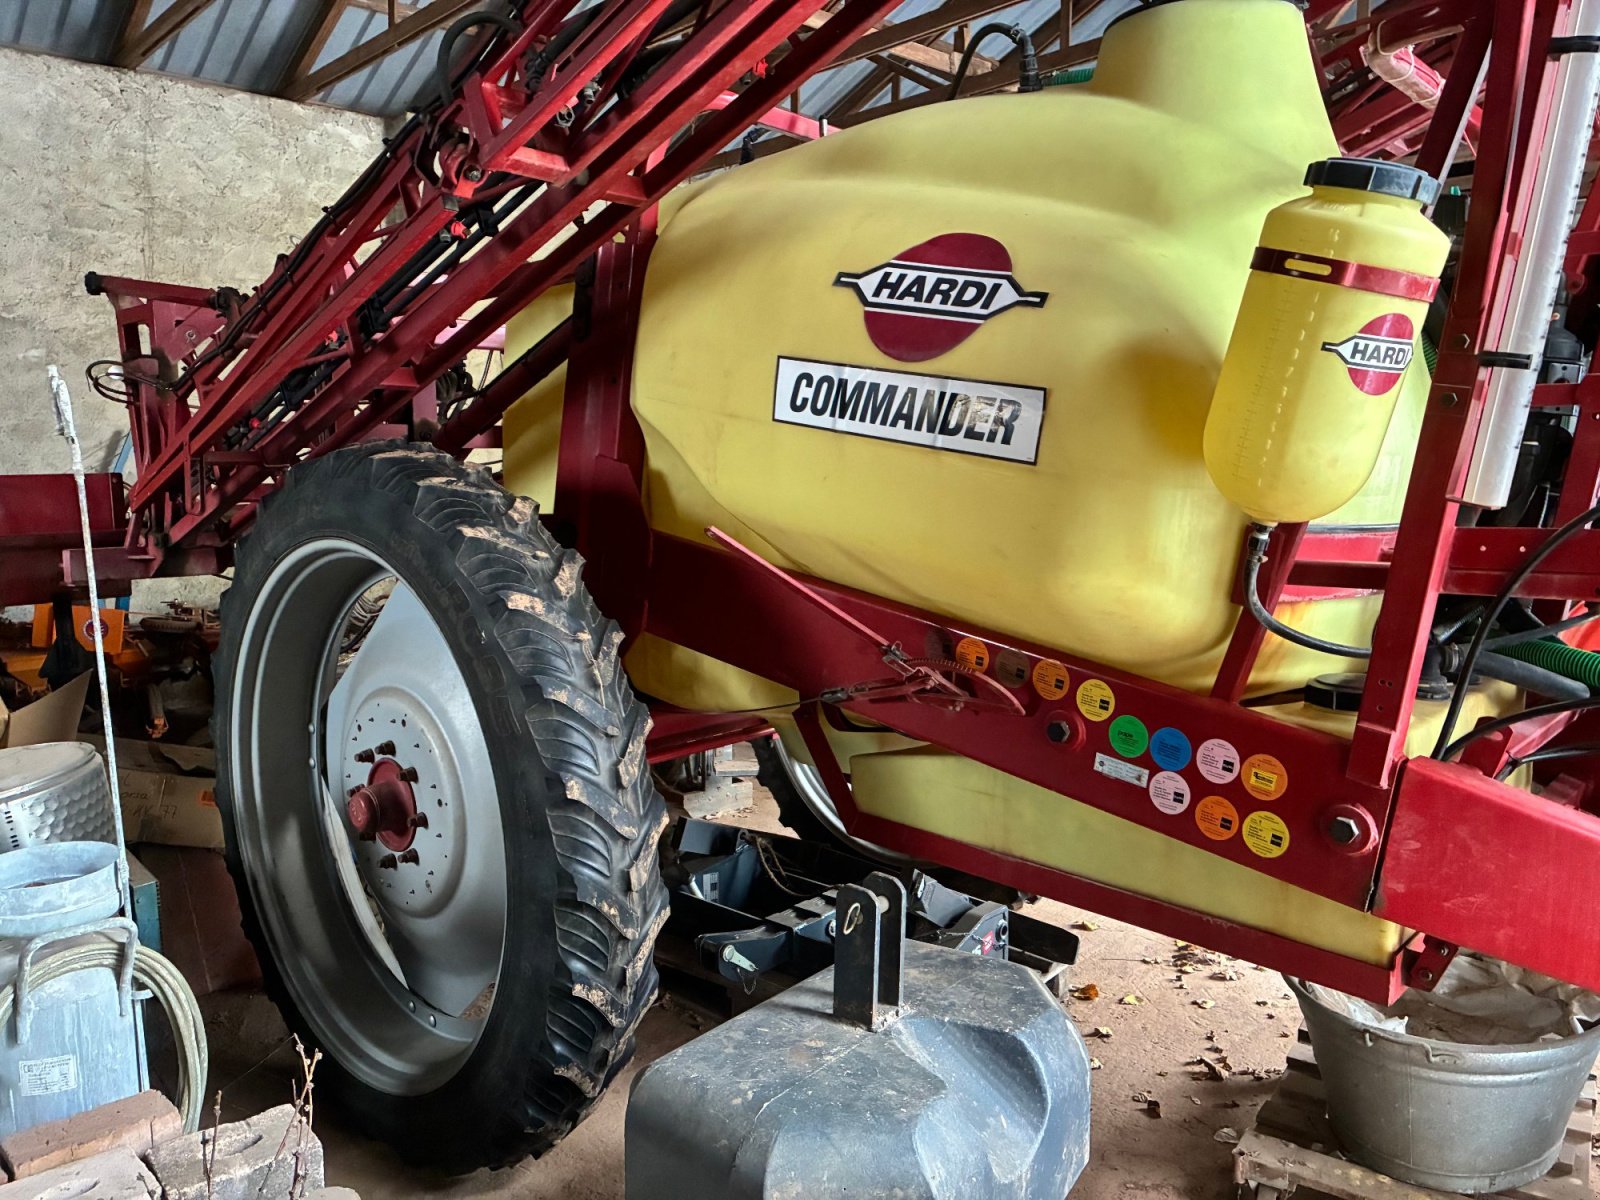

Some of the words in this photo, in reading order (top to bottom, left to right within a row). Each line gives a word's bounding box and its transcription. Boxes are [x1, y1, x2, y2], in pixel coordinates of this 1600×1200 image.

[871, 271, 1003, 310] HARDI
[1350, 340, 1409, 366] HARDI
[789, 371, 1023, 446] COMMANDER
